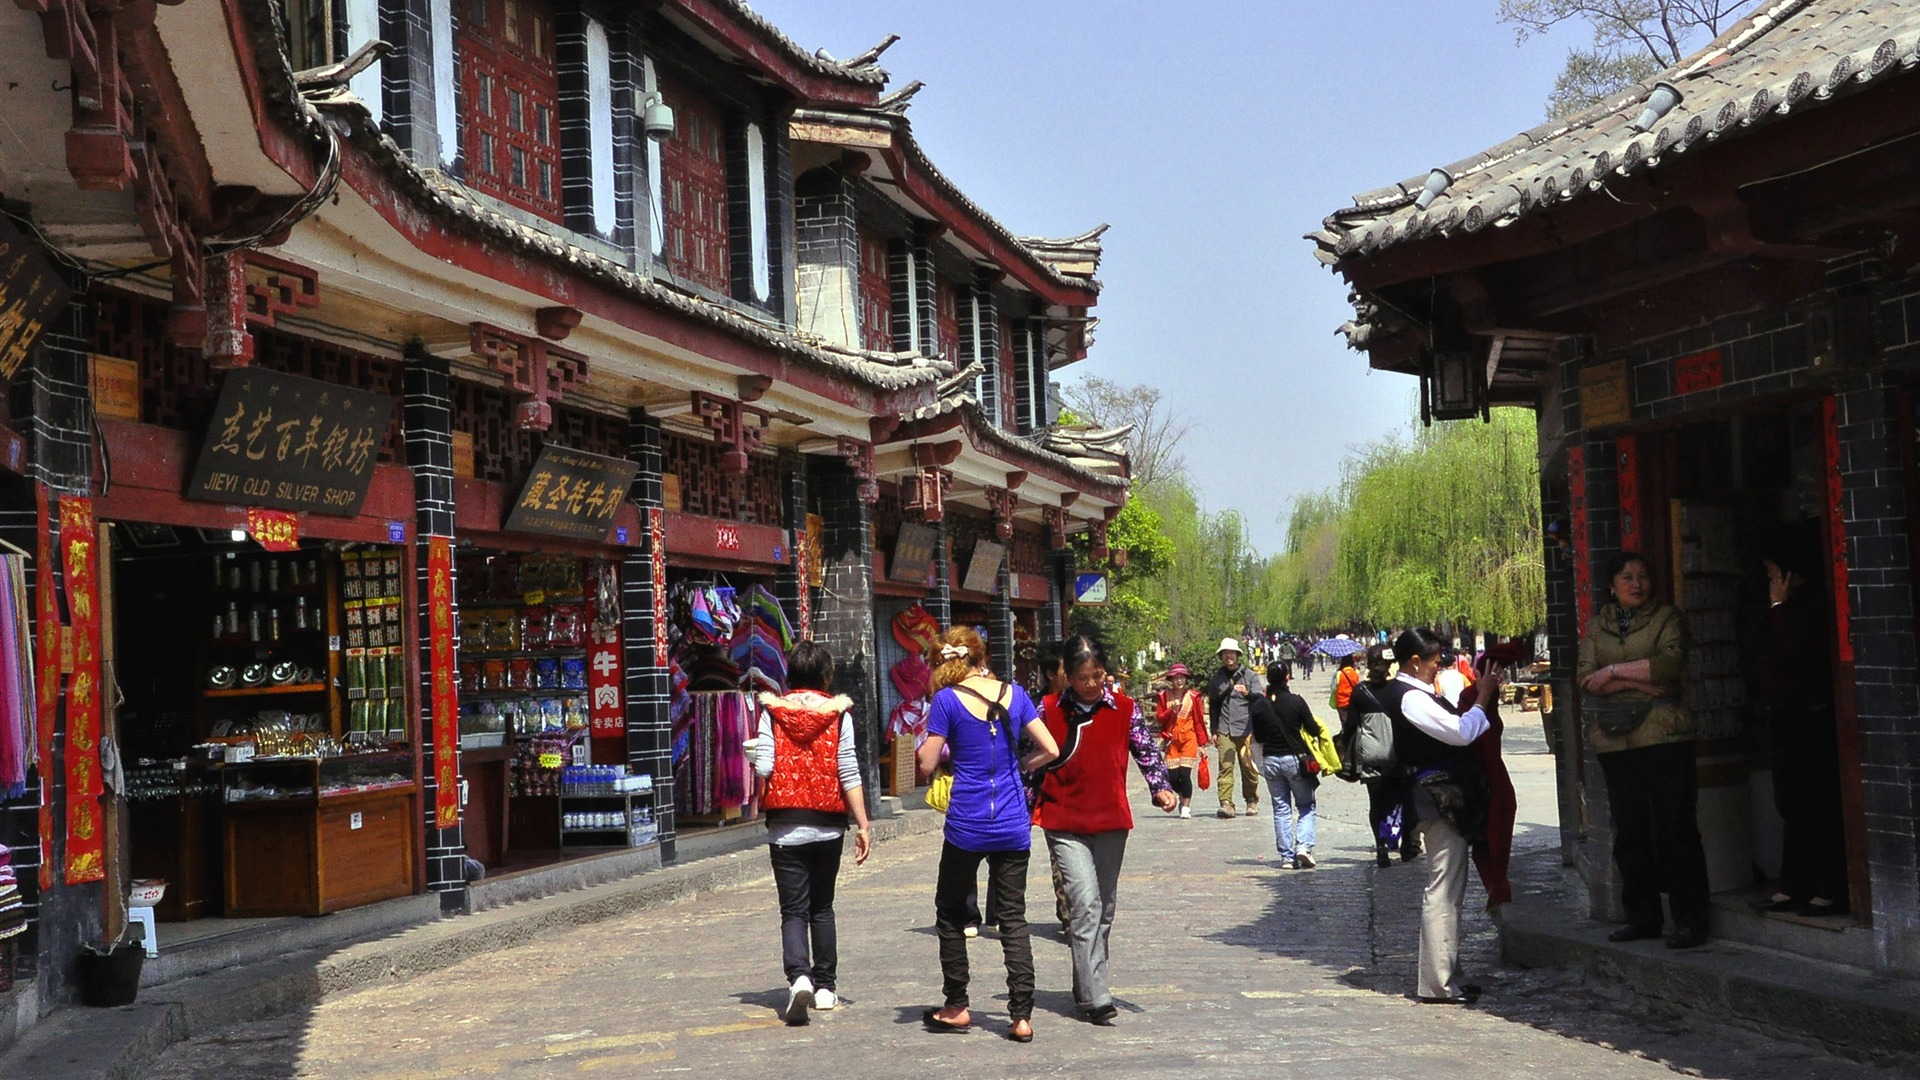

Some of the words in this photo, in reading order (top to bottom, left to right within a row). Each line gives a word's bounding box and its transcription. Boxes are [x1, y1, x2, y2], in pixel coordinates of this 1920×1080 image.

[204, 472, 239, 492] JIEYI
[243, 478, 271, 497] OLD
[275, 481, 319, 501] SILVER
[323, 488, 356, 507] SHOP
[592, 717, 624, 729] 专卖店
